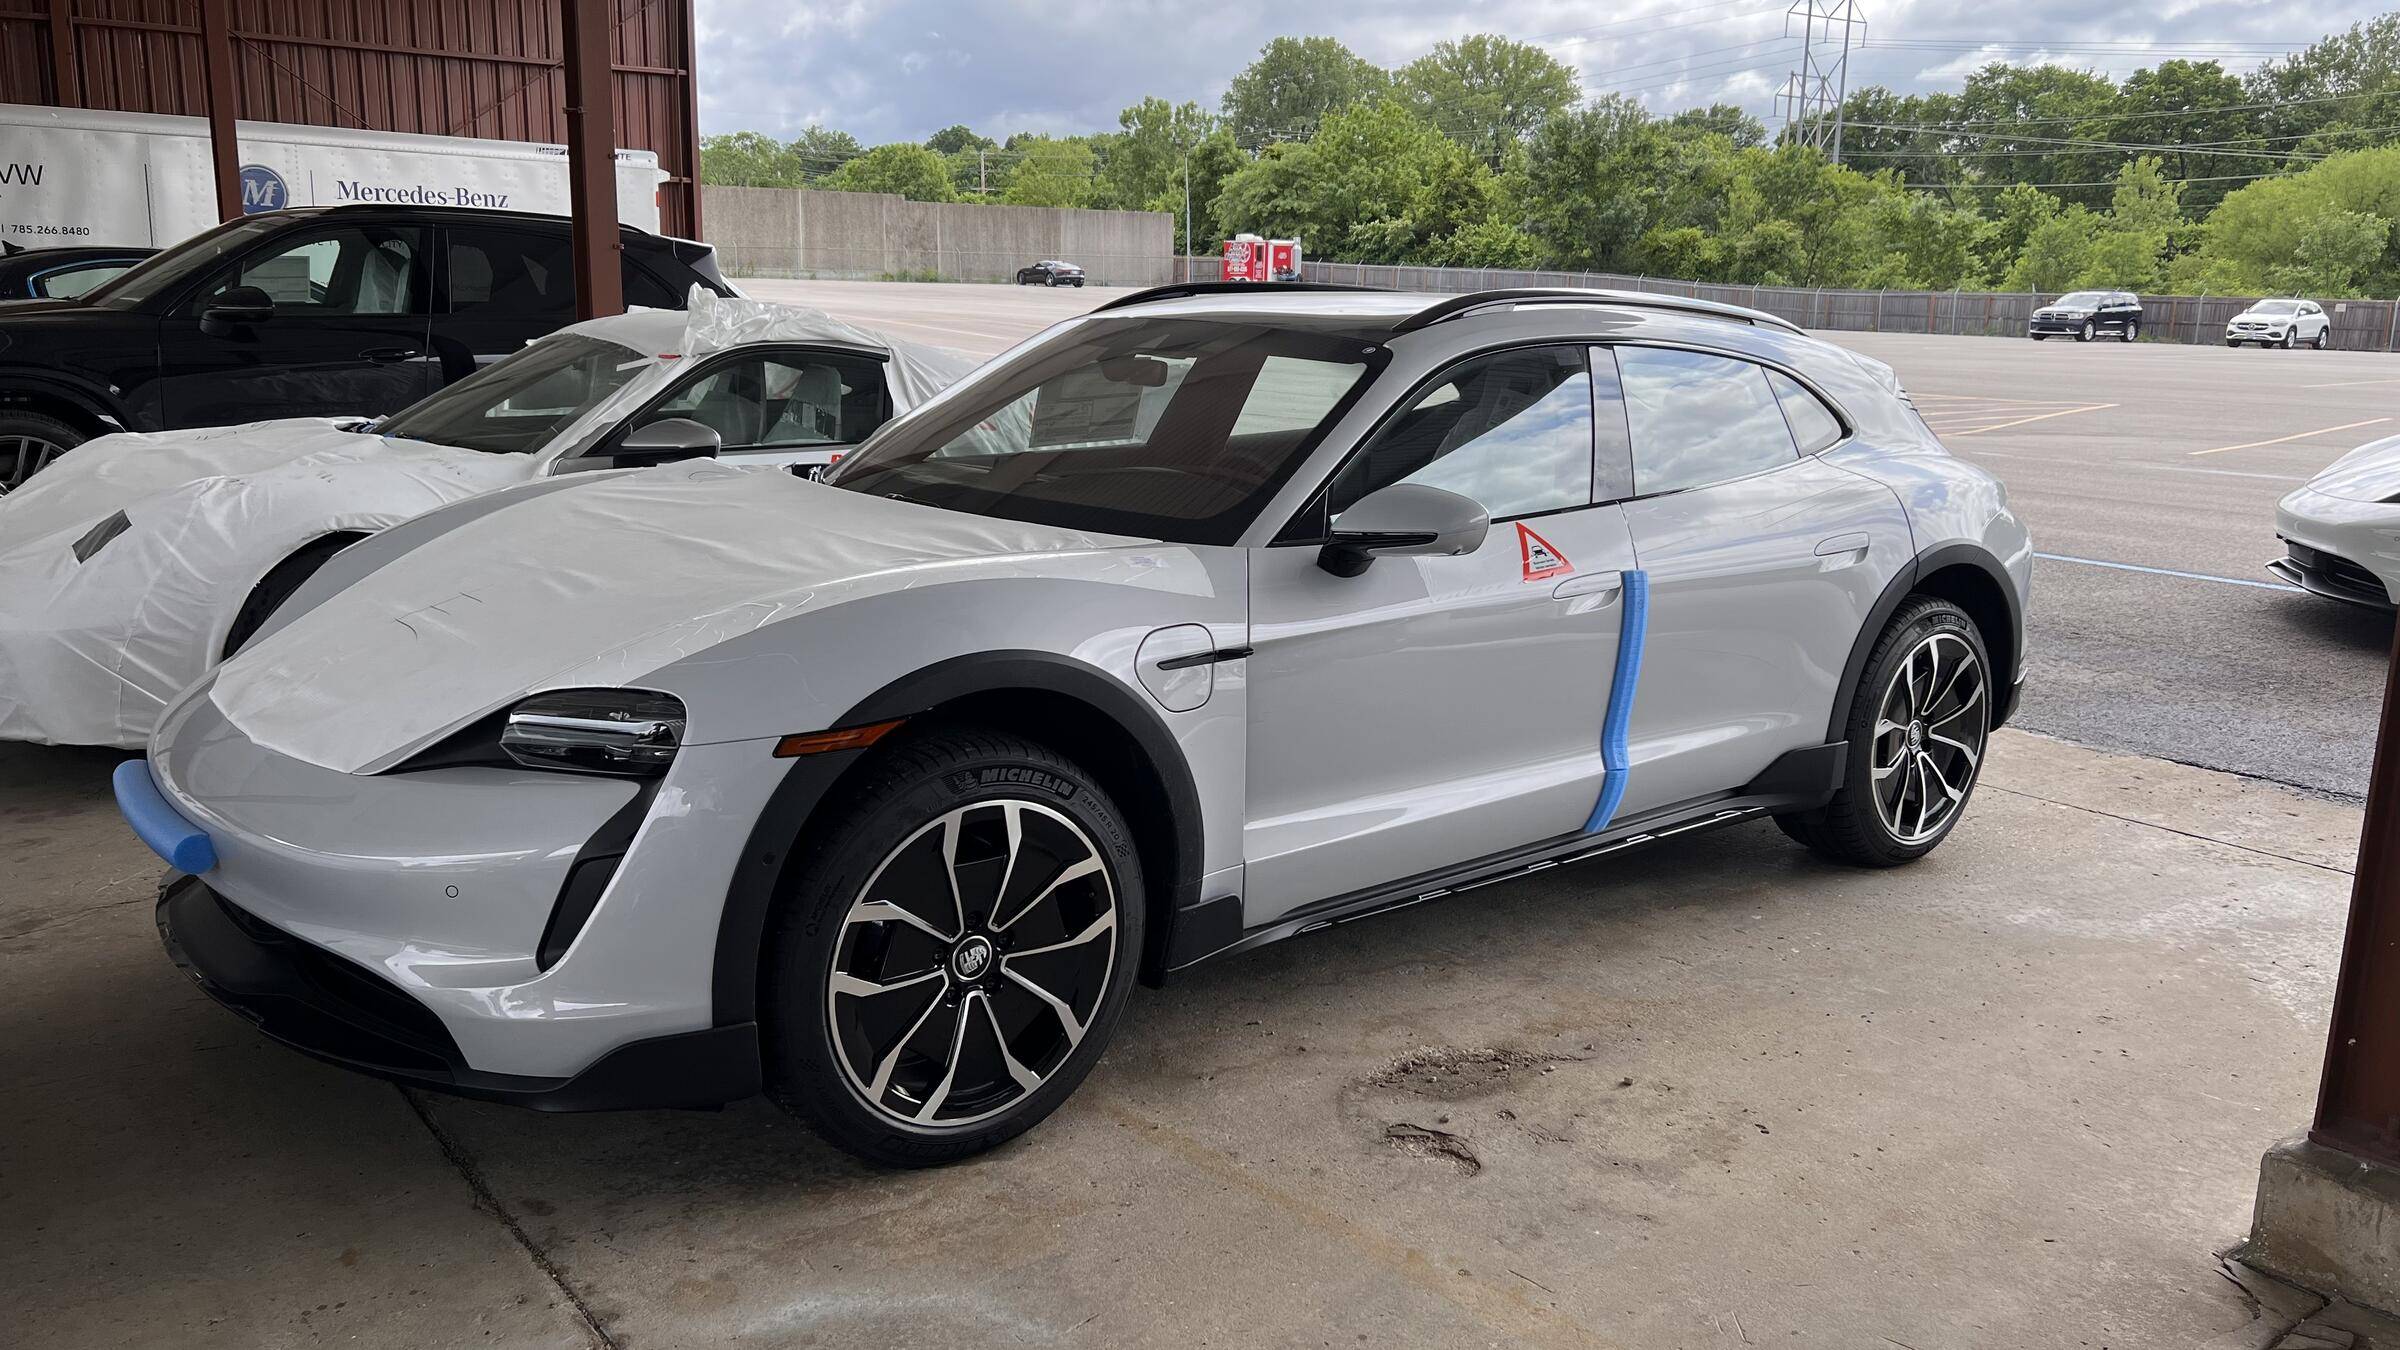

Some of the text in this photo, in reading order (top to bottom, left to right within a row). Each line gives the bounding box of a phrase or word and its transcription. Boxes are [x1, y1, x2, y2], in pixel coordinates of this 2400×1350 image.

[336, 180, 508, 208] Mercedes-Benz
[11, 225, 90, 236] 785.266.8480
[980, 768, 1074, 797] MICHELIN
